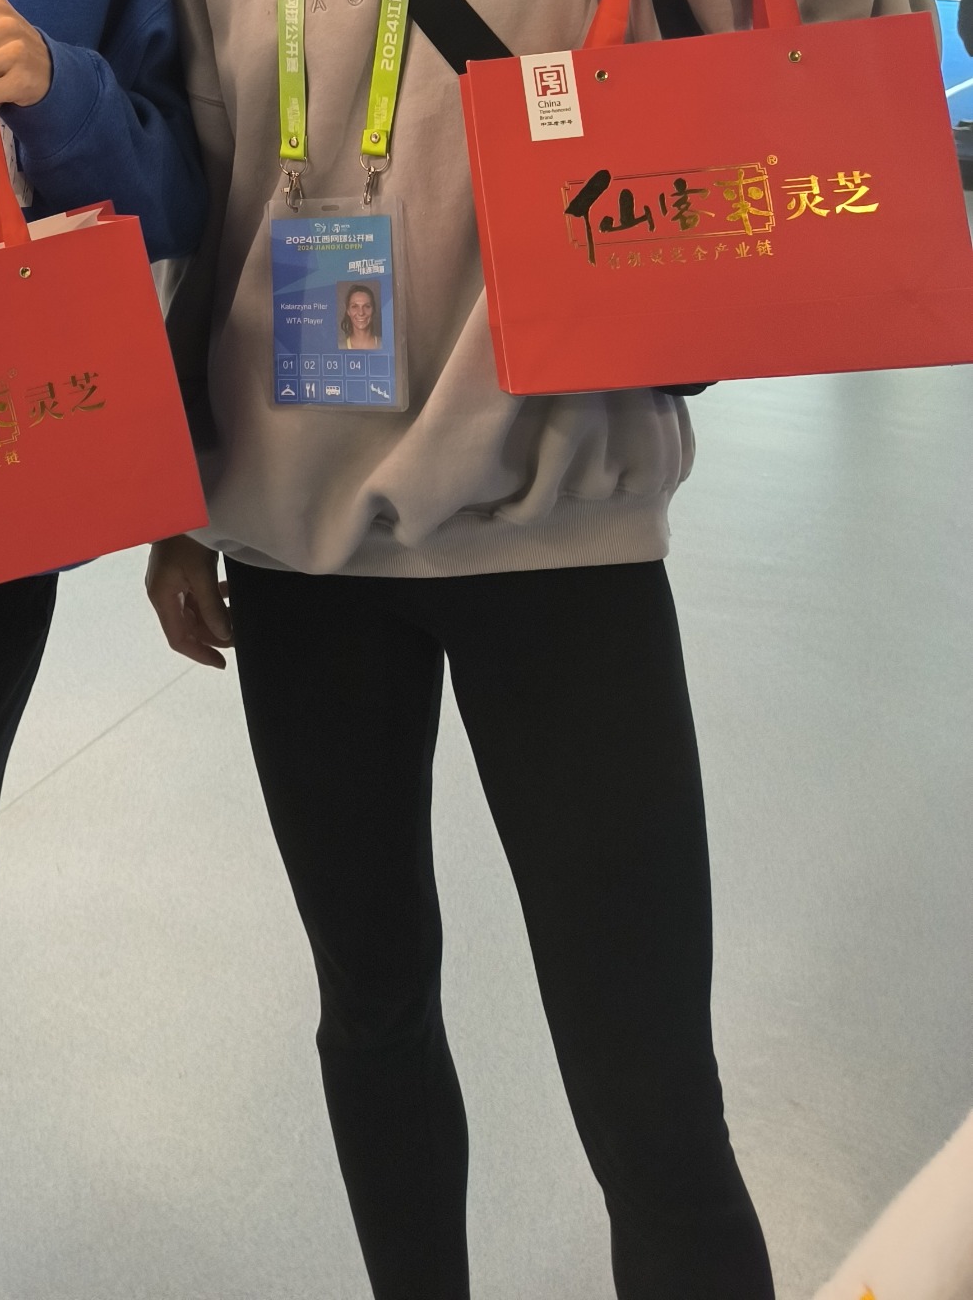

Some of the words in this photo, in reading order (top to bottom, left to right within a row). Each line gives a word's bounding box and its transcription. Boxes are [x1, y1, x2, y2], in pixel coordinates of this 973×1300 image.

[537, 100, 562, 109] China
[780, 170, 880, 221] 灵芝
[314, 243, 343, 251] JIANGXI
[344, 242, 363, 250] OPEN
[303, 317, 323, 326] Player
[282, 360, 294, 370] 01
[304, 360, 316, 370] 02
[326, 360, 338, 370] 03
[349, 361, 362, 370] 04
[23, 372, 107, 428] 灵芝
